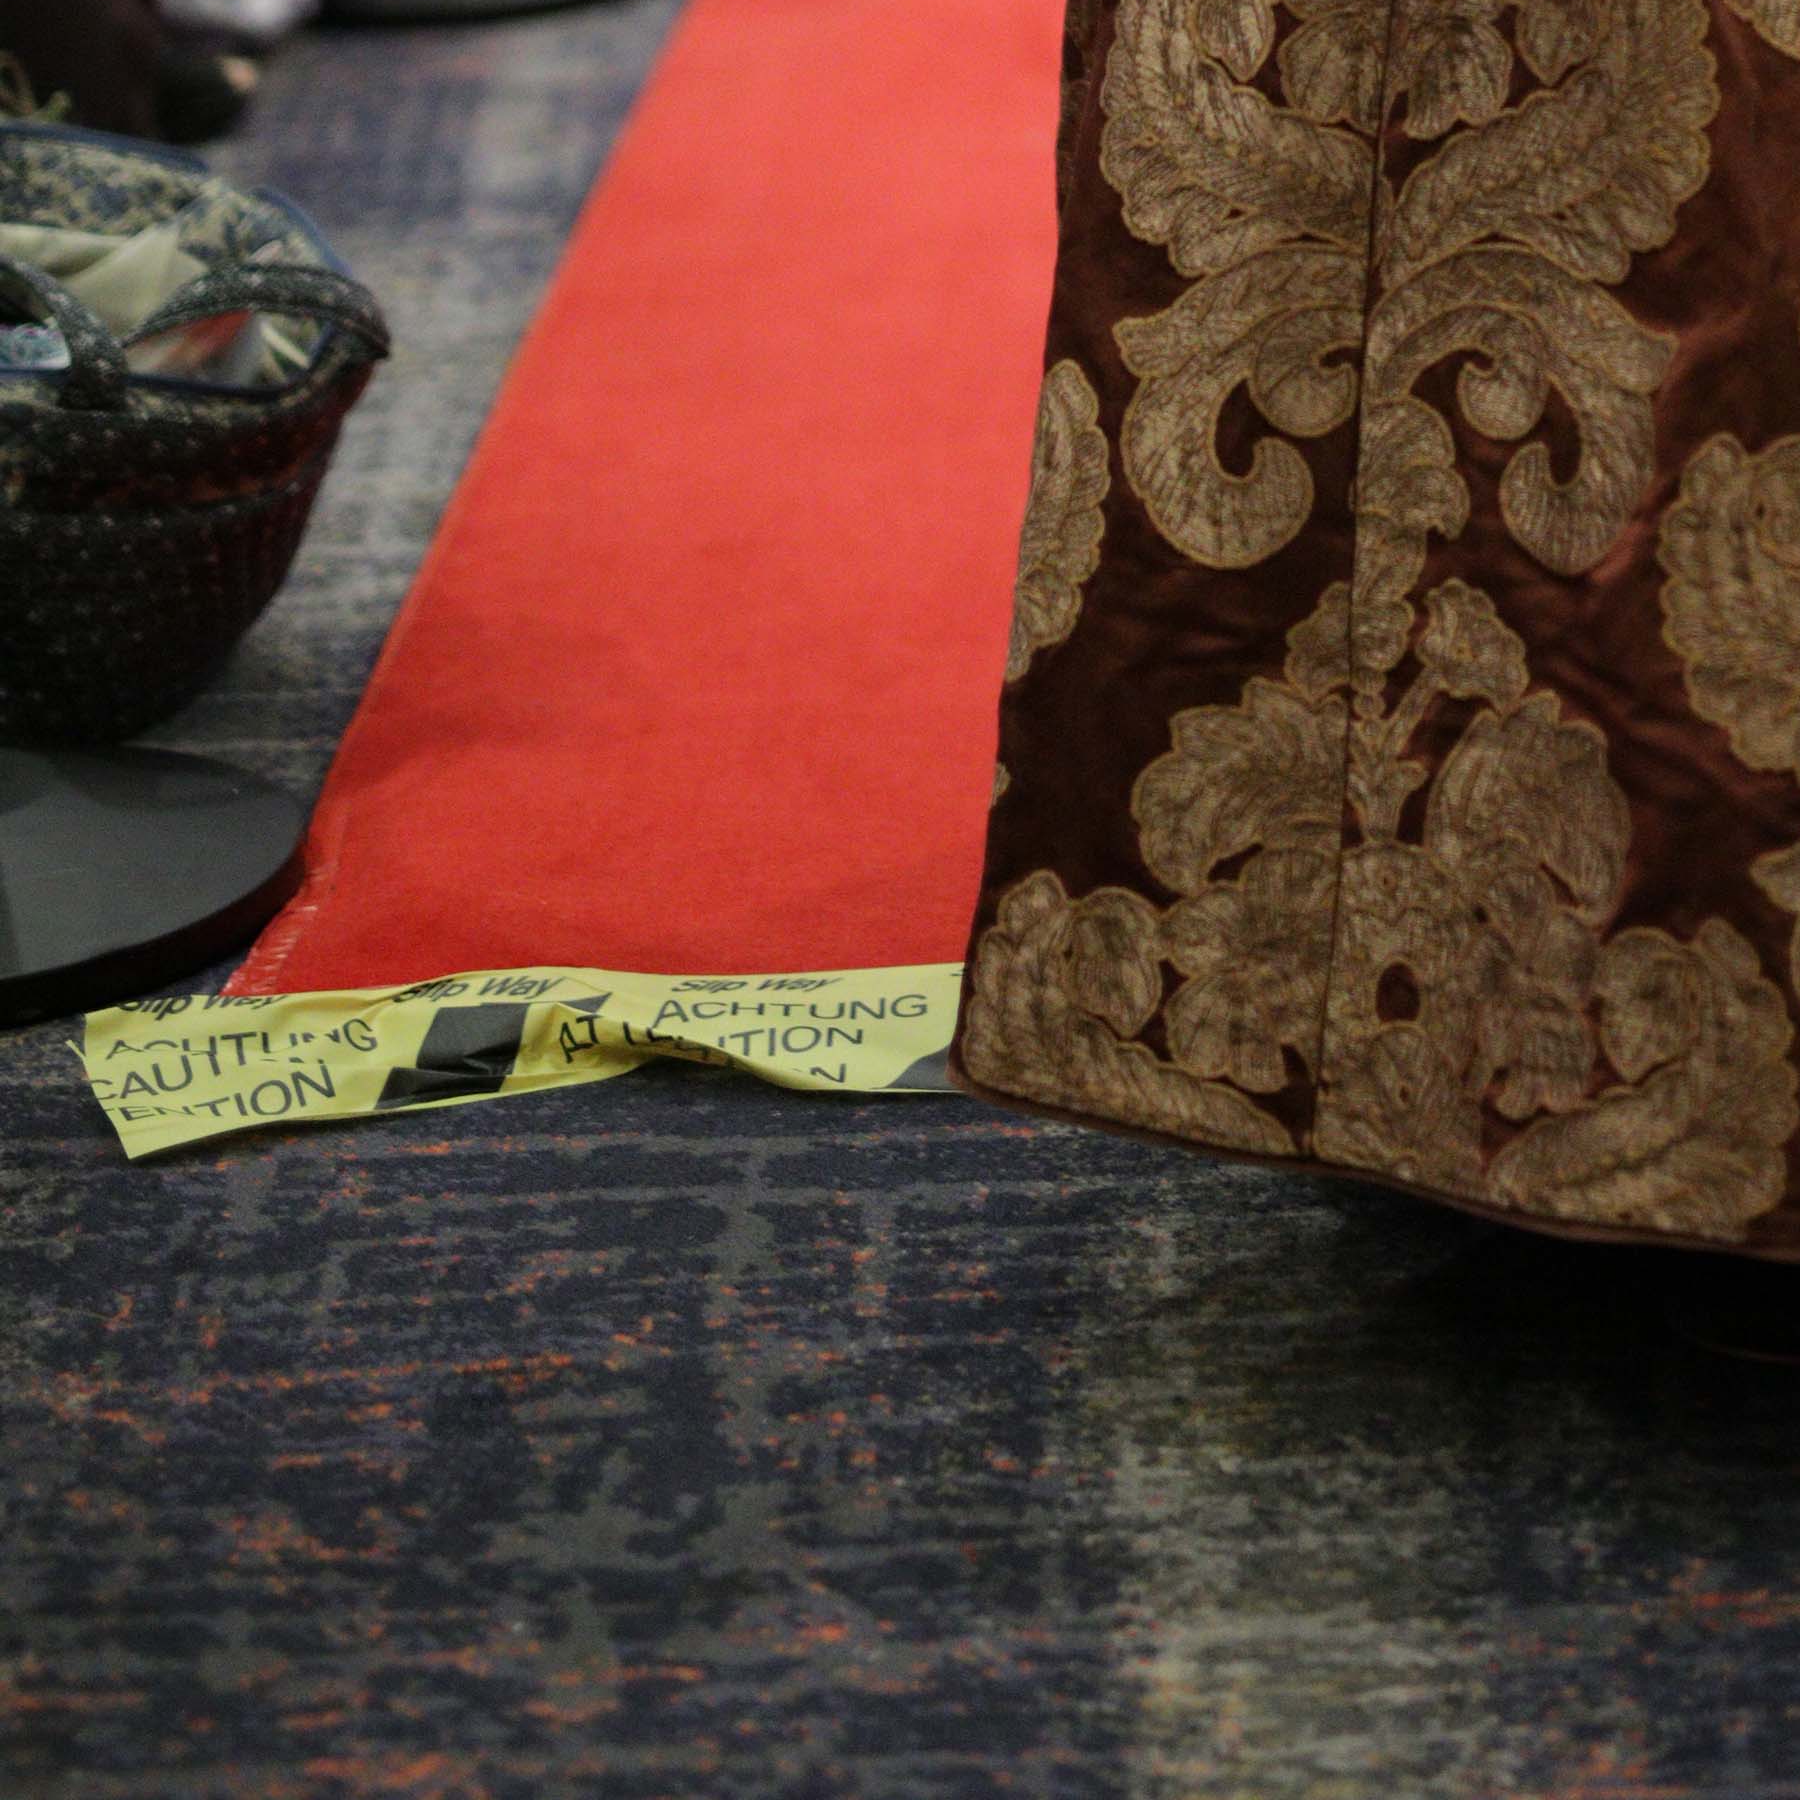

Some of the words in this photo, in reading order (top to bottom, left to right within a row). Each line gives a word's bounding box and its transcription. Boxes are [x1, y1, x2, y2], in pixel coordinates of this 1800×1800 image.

[392, 978, 470, 1003] Slip
[477, 975, 566, 1000] Way
[671, 978, 748, 993] Slip
[756, 976, 843, 992] Way
[652, 994, 929, 1029] ACHTUNG
[102, 1063, 337, 1122] ENTION
